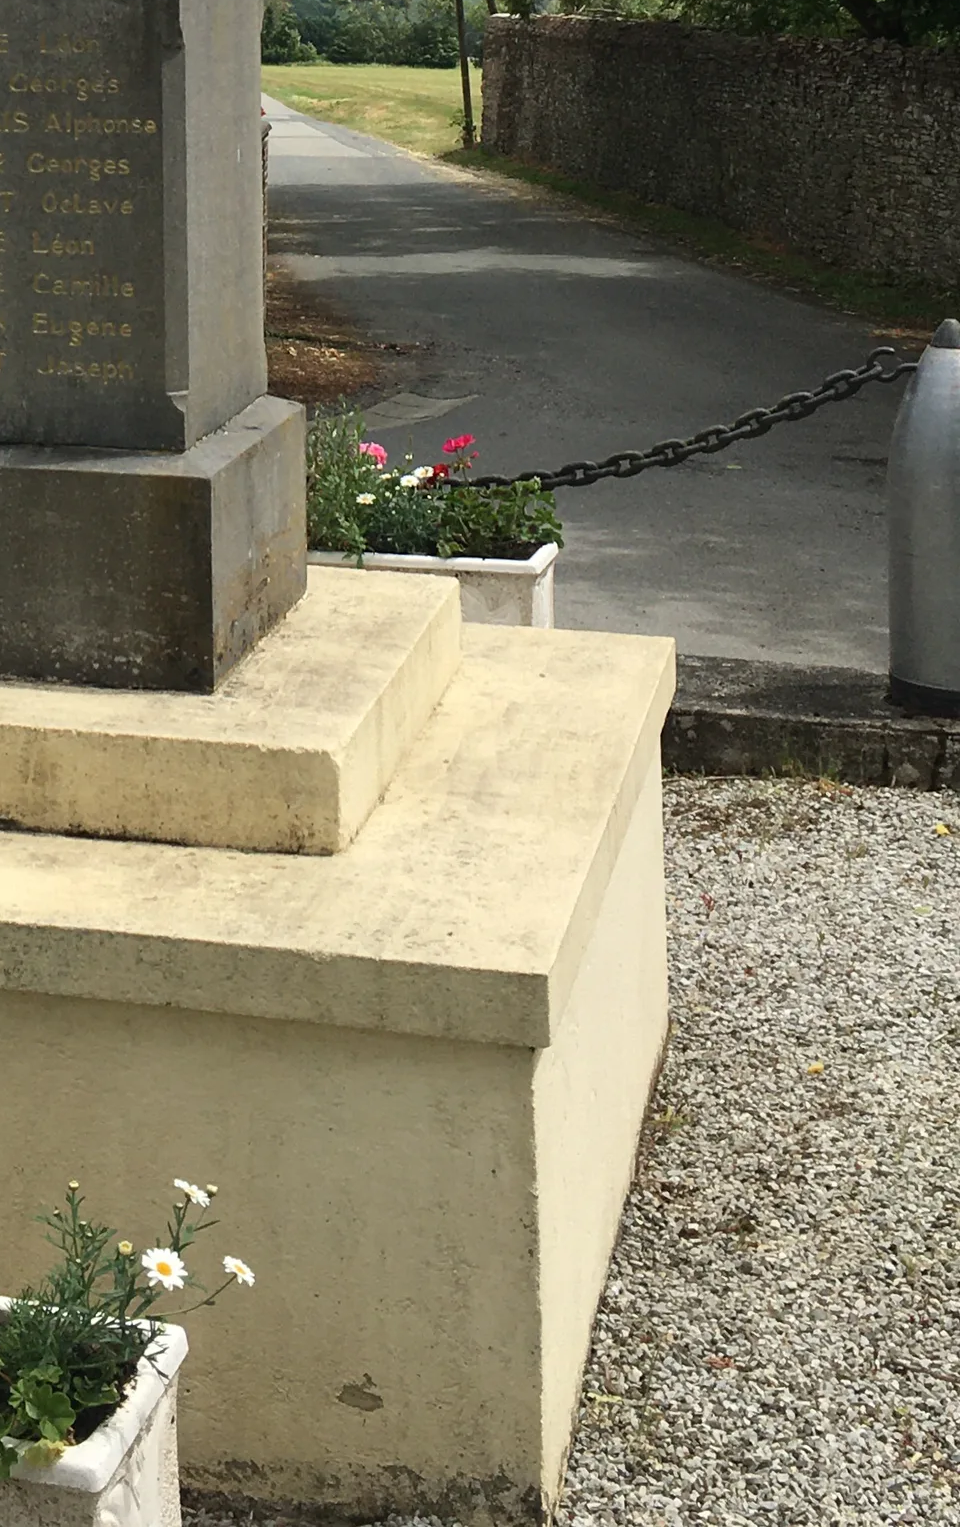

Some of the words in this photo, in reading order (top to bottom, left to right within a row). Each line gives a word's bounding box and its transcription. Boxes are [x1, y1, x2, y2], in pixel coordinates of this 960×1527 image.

[44, 113, 158, 139] Alphonse
[26, 152, 131, 181] Georges
[42, 190, 136, 215] Octave
[32, 230, 95, 256] Léon
[32, 273, 136, 298] Camille
